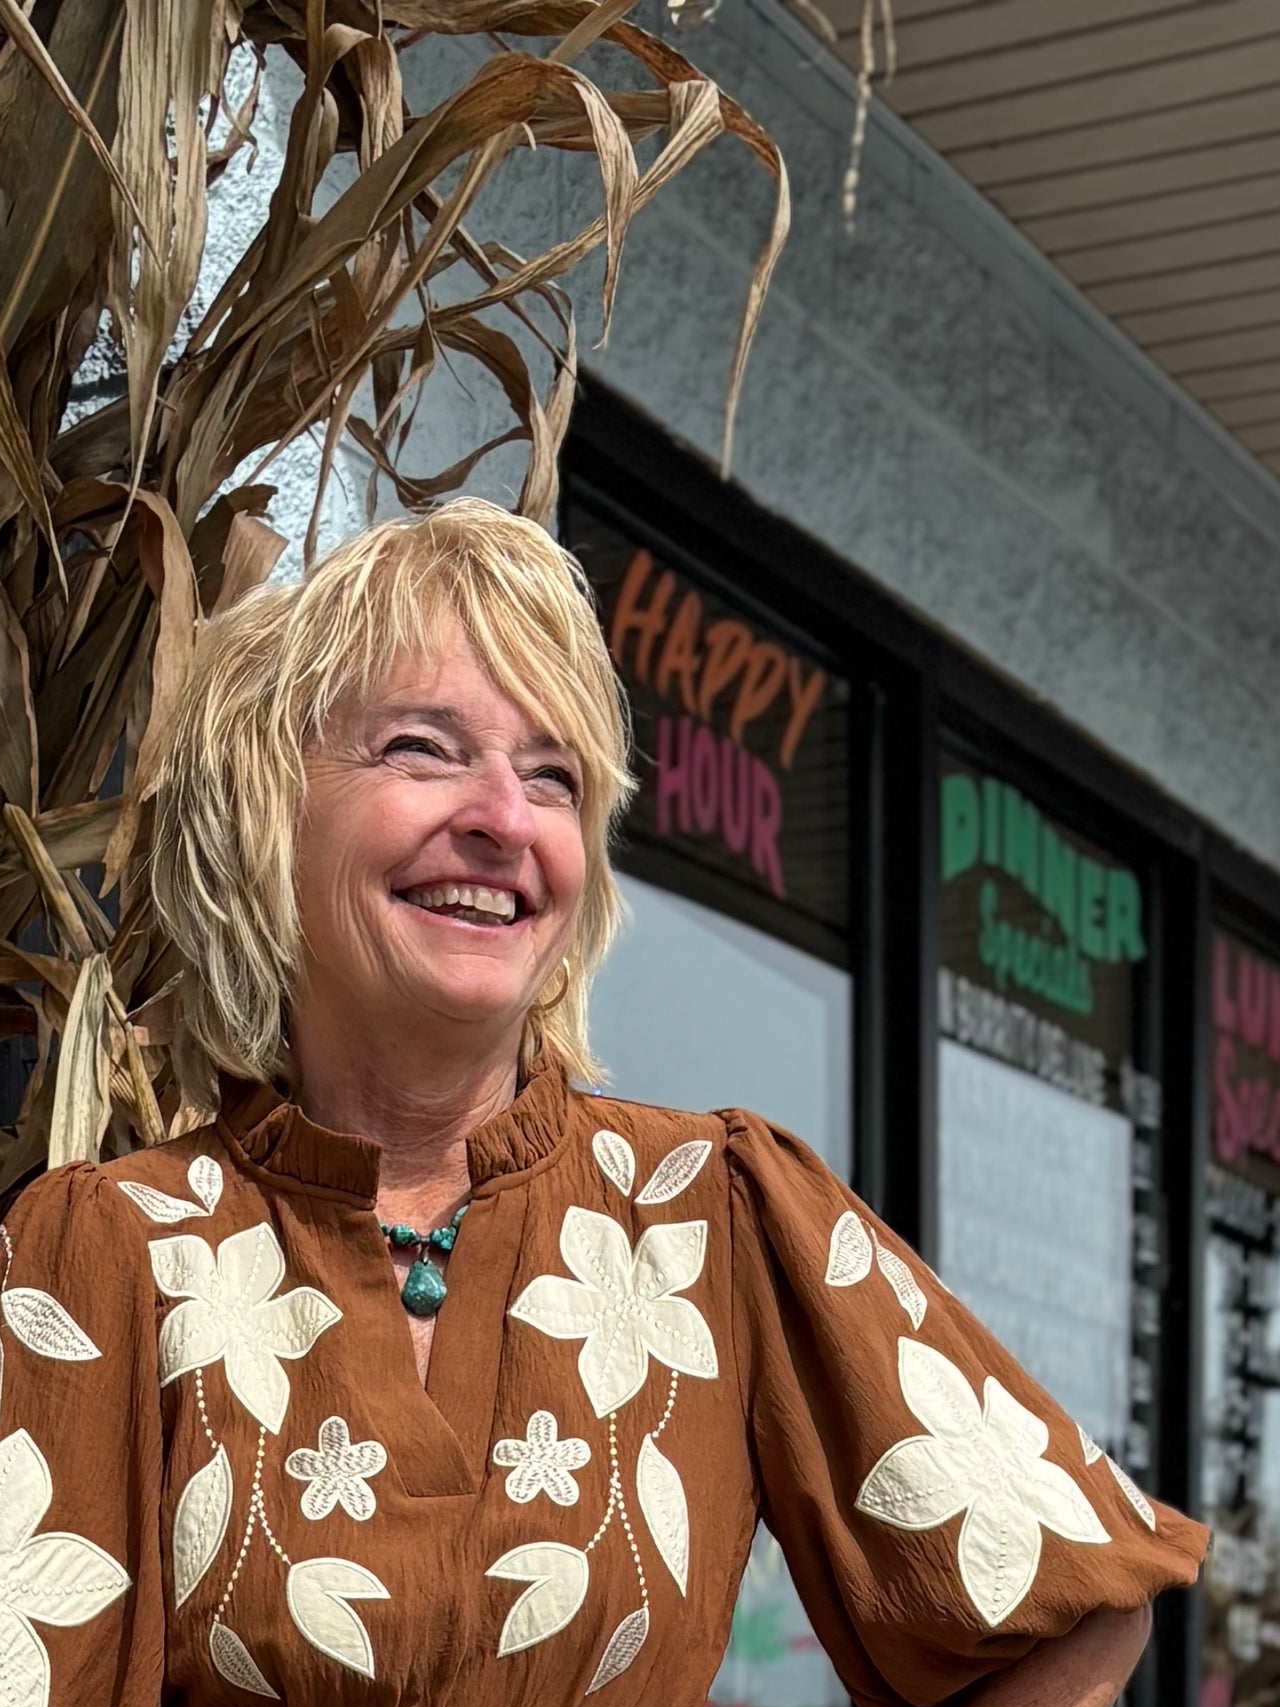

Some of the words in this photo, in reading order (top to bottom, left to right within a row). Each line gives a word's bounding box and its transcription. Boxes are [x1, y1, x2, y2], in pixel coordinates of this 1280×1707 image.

[611, 549, 825, 773] HAPPY
[655, 714, 787, 899] HOUR
[939, 773, 1147, 964] DINNER
